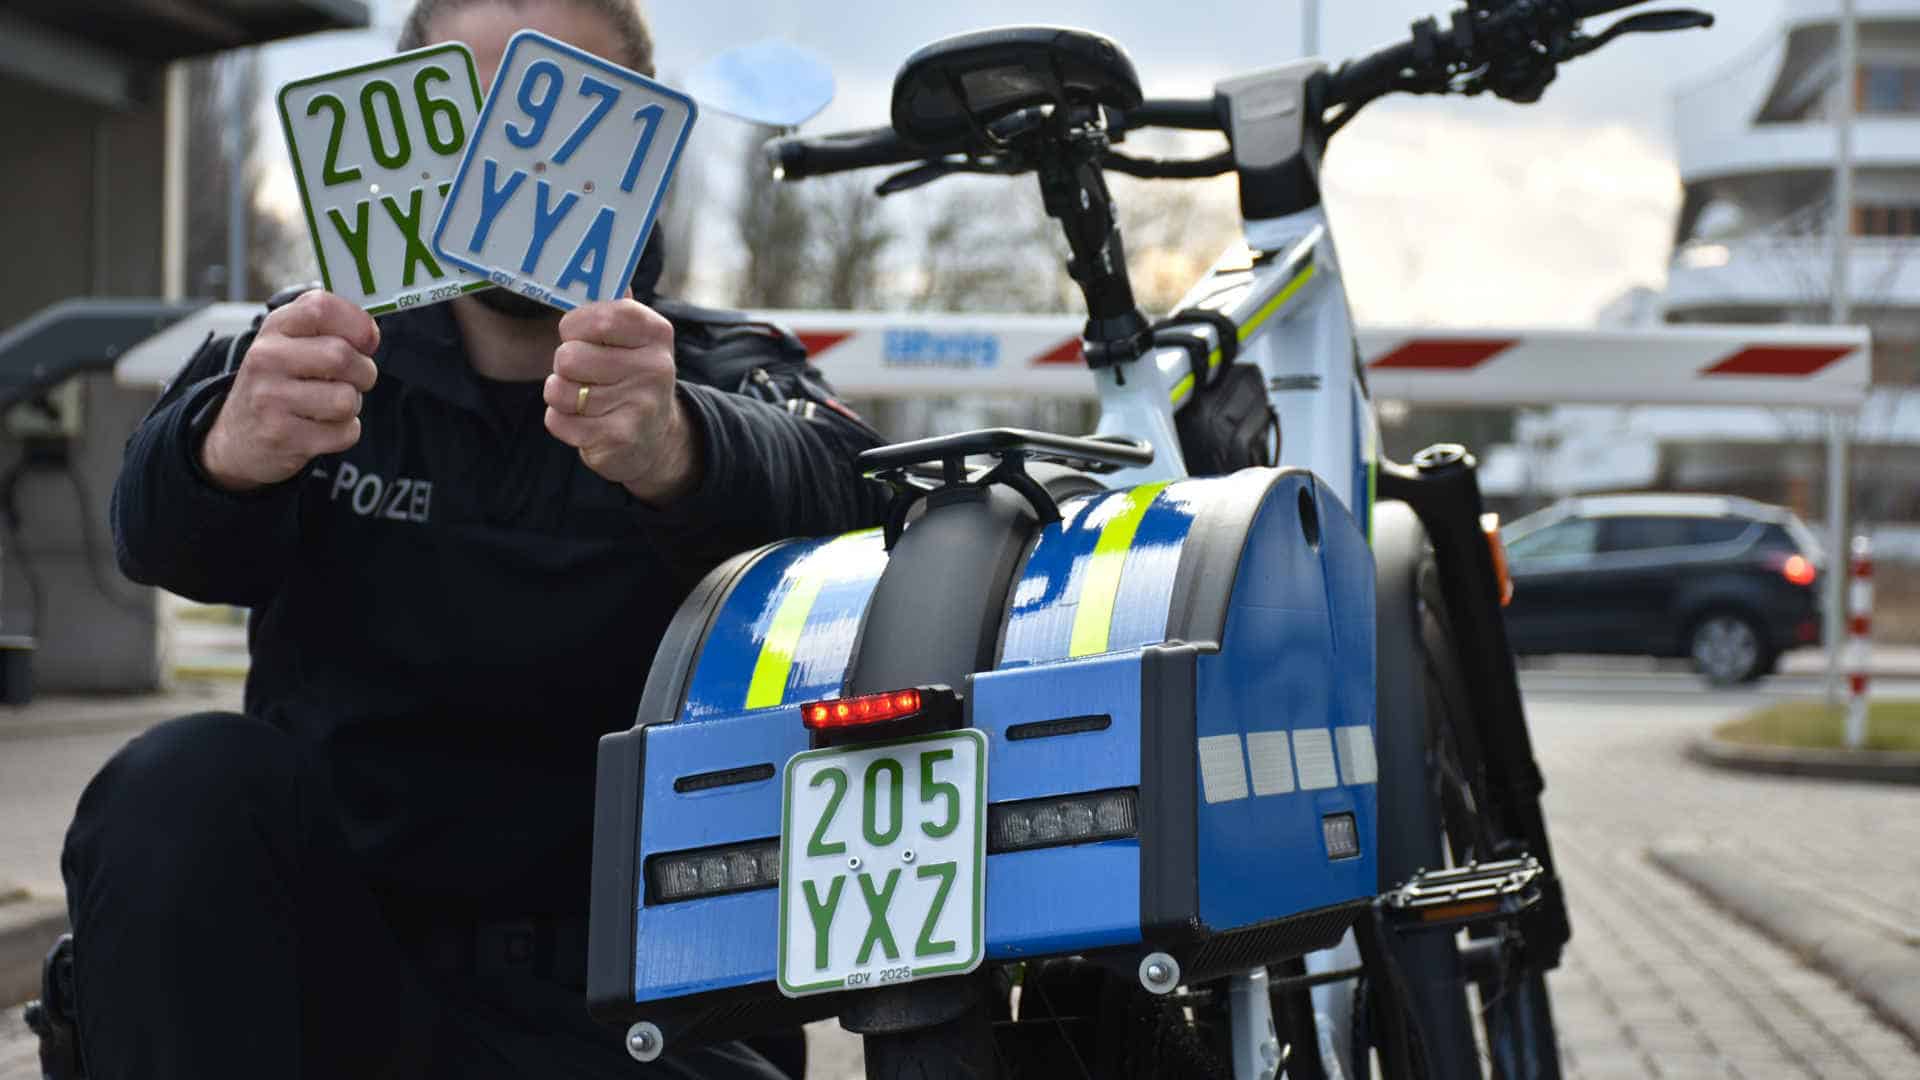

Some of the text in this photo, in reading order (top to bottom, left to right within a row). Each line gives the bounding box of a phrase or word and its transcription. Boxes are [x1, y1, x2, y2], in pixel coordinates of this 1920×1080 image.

[306, 66, 465, 186] 206
[504, 60, 665, 193] 971
[327, 183, 466, 296] YX
[468, 160, 616, 301] YYA
[398, 284, 461, 308] GDV 2025
[491, 271, 550, 301] GDV 2024
[330, 461, 432, 522] POZEI
[807, 748, 961, 858] 205
[802, 861, 957, 970] YXZ
[847, 966, 911, 985] GDV 2025
